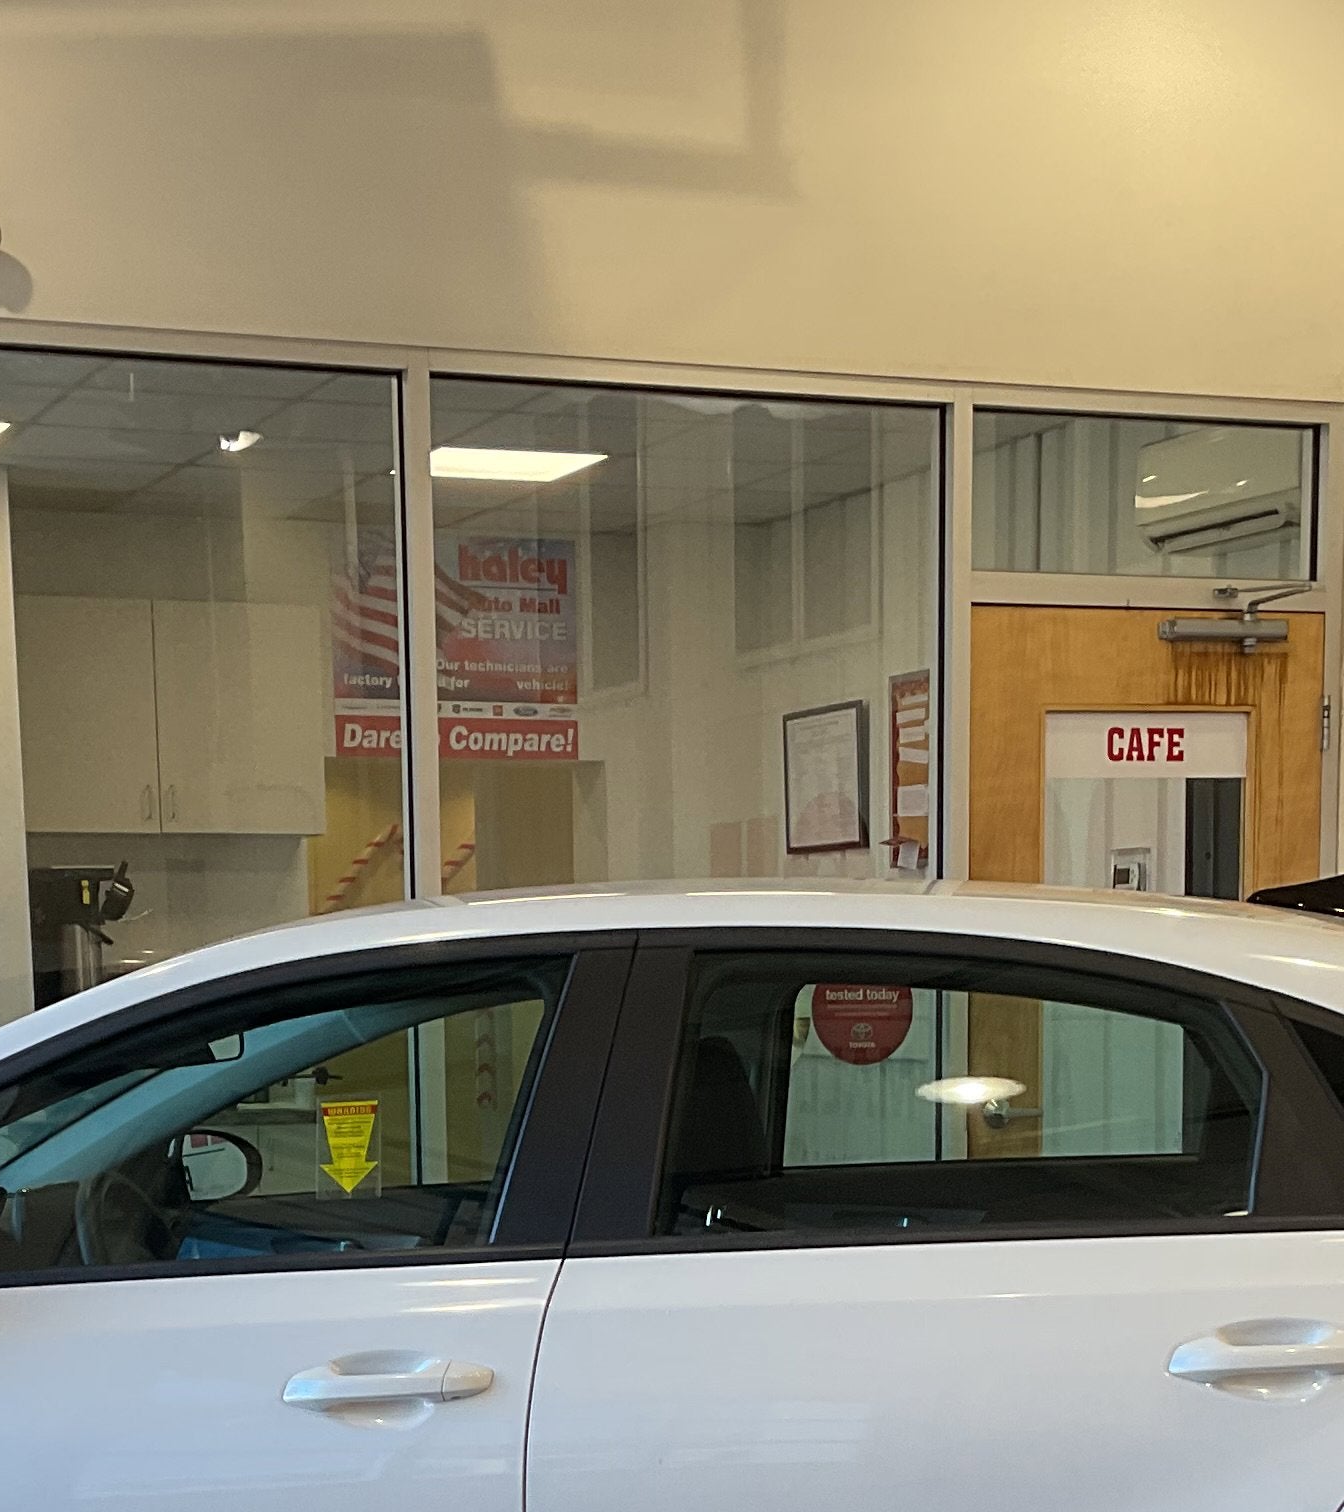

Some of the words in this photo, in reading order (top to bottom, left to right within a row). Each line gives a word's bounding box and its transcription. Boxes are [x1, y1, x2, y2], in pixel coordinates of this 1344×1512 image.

[458, 543, 568, 595] haley
[520, 597, 561, 615] Mall
[460, 618, 568, 640] SERVICE
[464, 660, 541, 673] technicians
[344, 673, 393, 689] factory
[343, 723, 402, 749] Dare
[449, 725, 574, 757] Compare!
[1107, 727, 1185, 762] CAFE
[825, 988, 863, 1001] tested
[866, 988, 900, 1003] today
